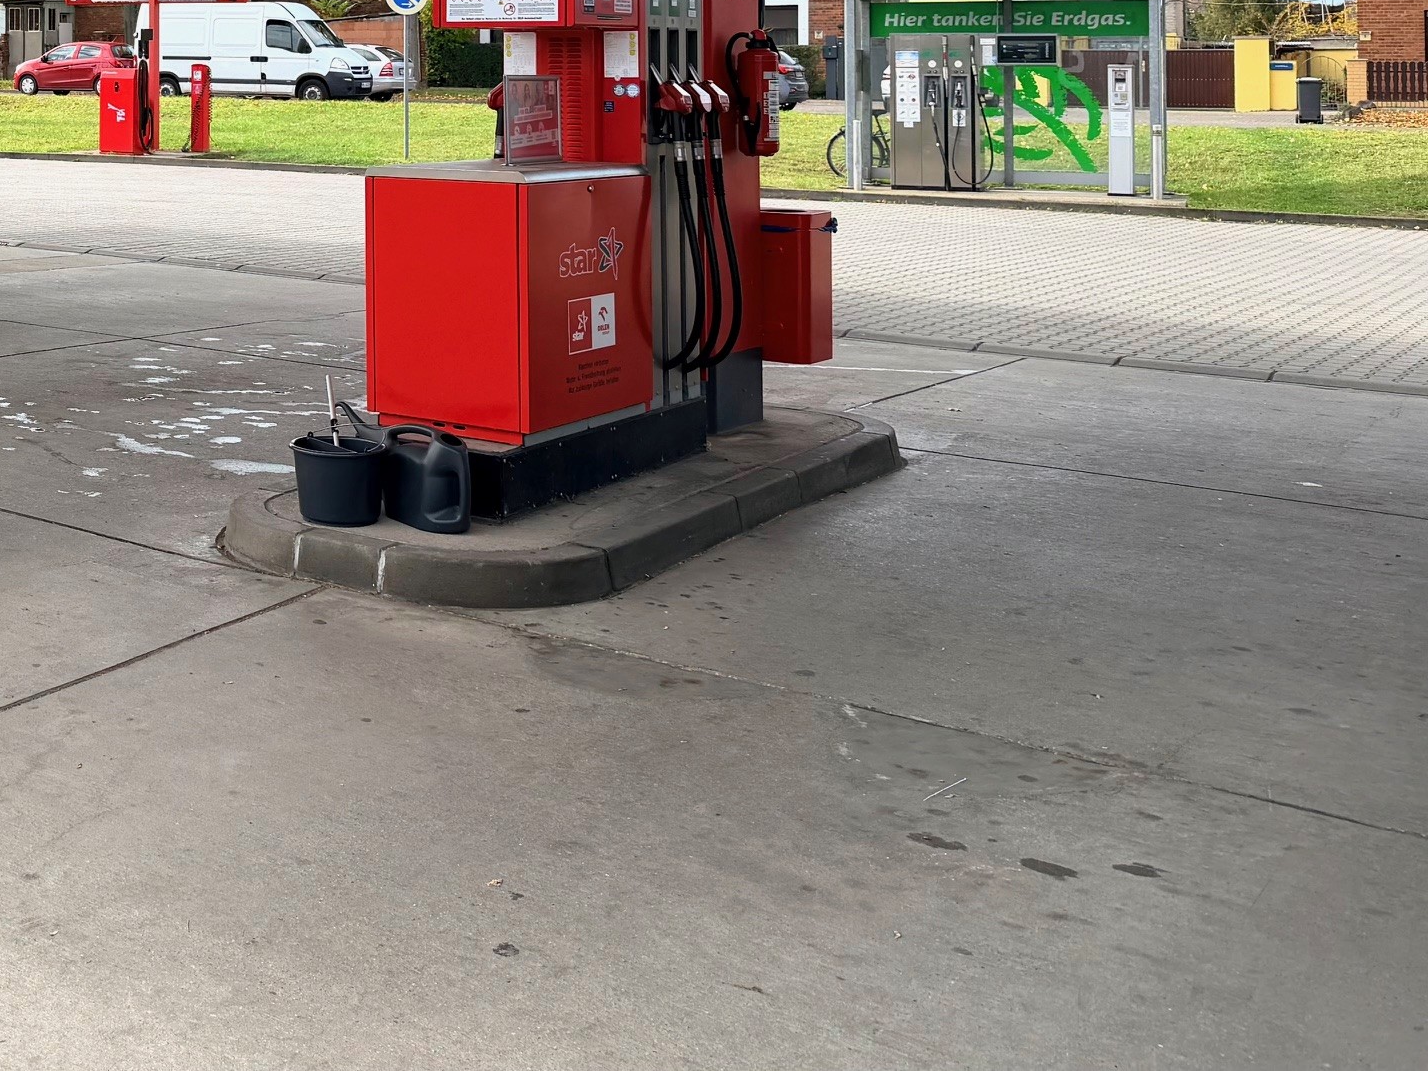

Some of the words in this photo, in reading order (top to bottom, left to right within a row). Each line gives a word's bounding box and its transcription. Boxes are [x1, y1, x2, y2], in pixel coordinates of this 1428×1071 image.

[884, 12, 927, 27] Hier
[932, 11, 1004, 27] tanken
[1012, 11, 1044, 27] Sie
[1050, 11, 1132, 29] Erdgas.
[559, 242, 597, 278] star
[572, 330, 585, 342] star
